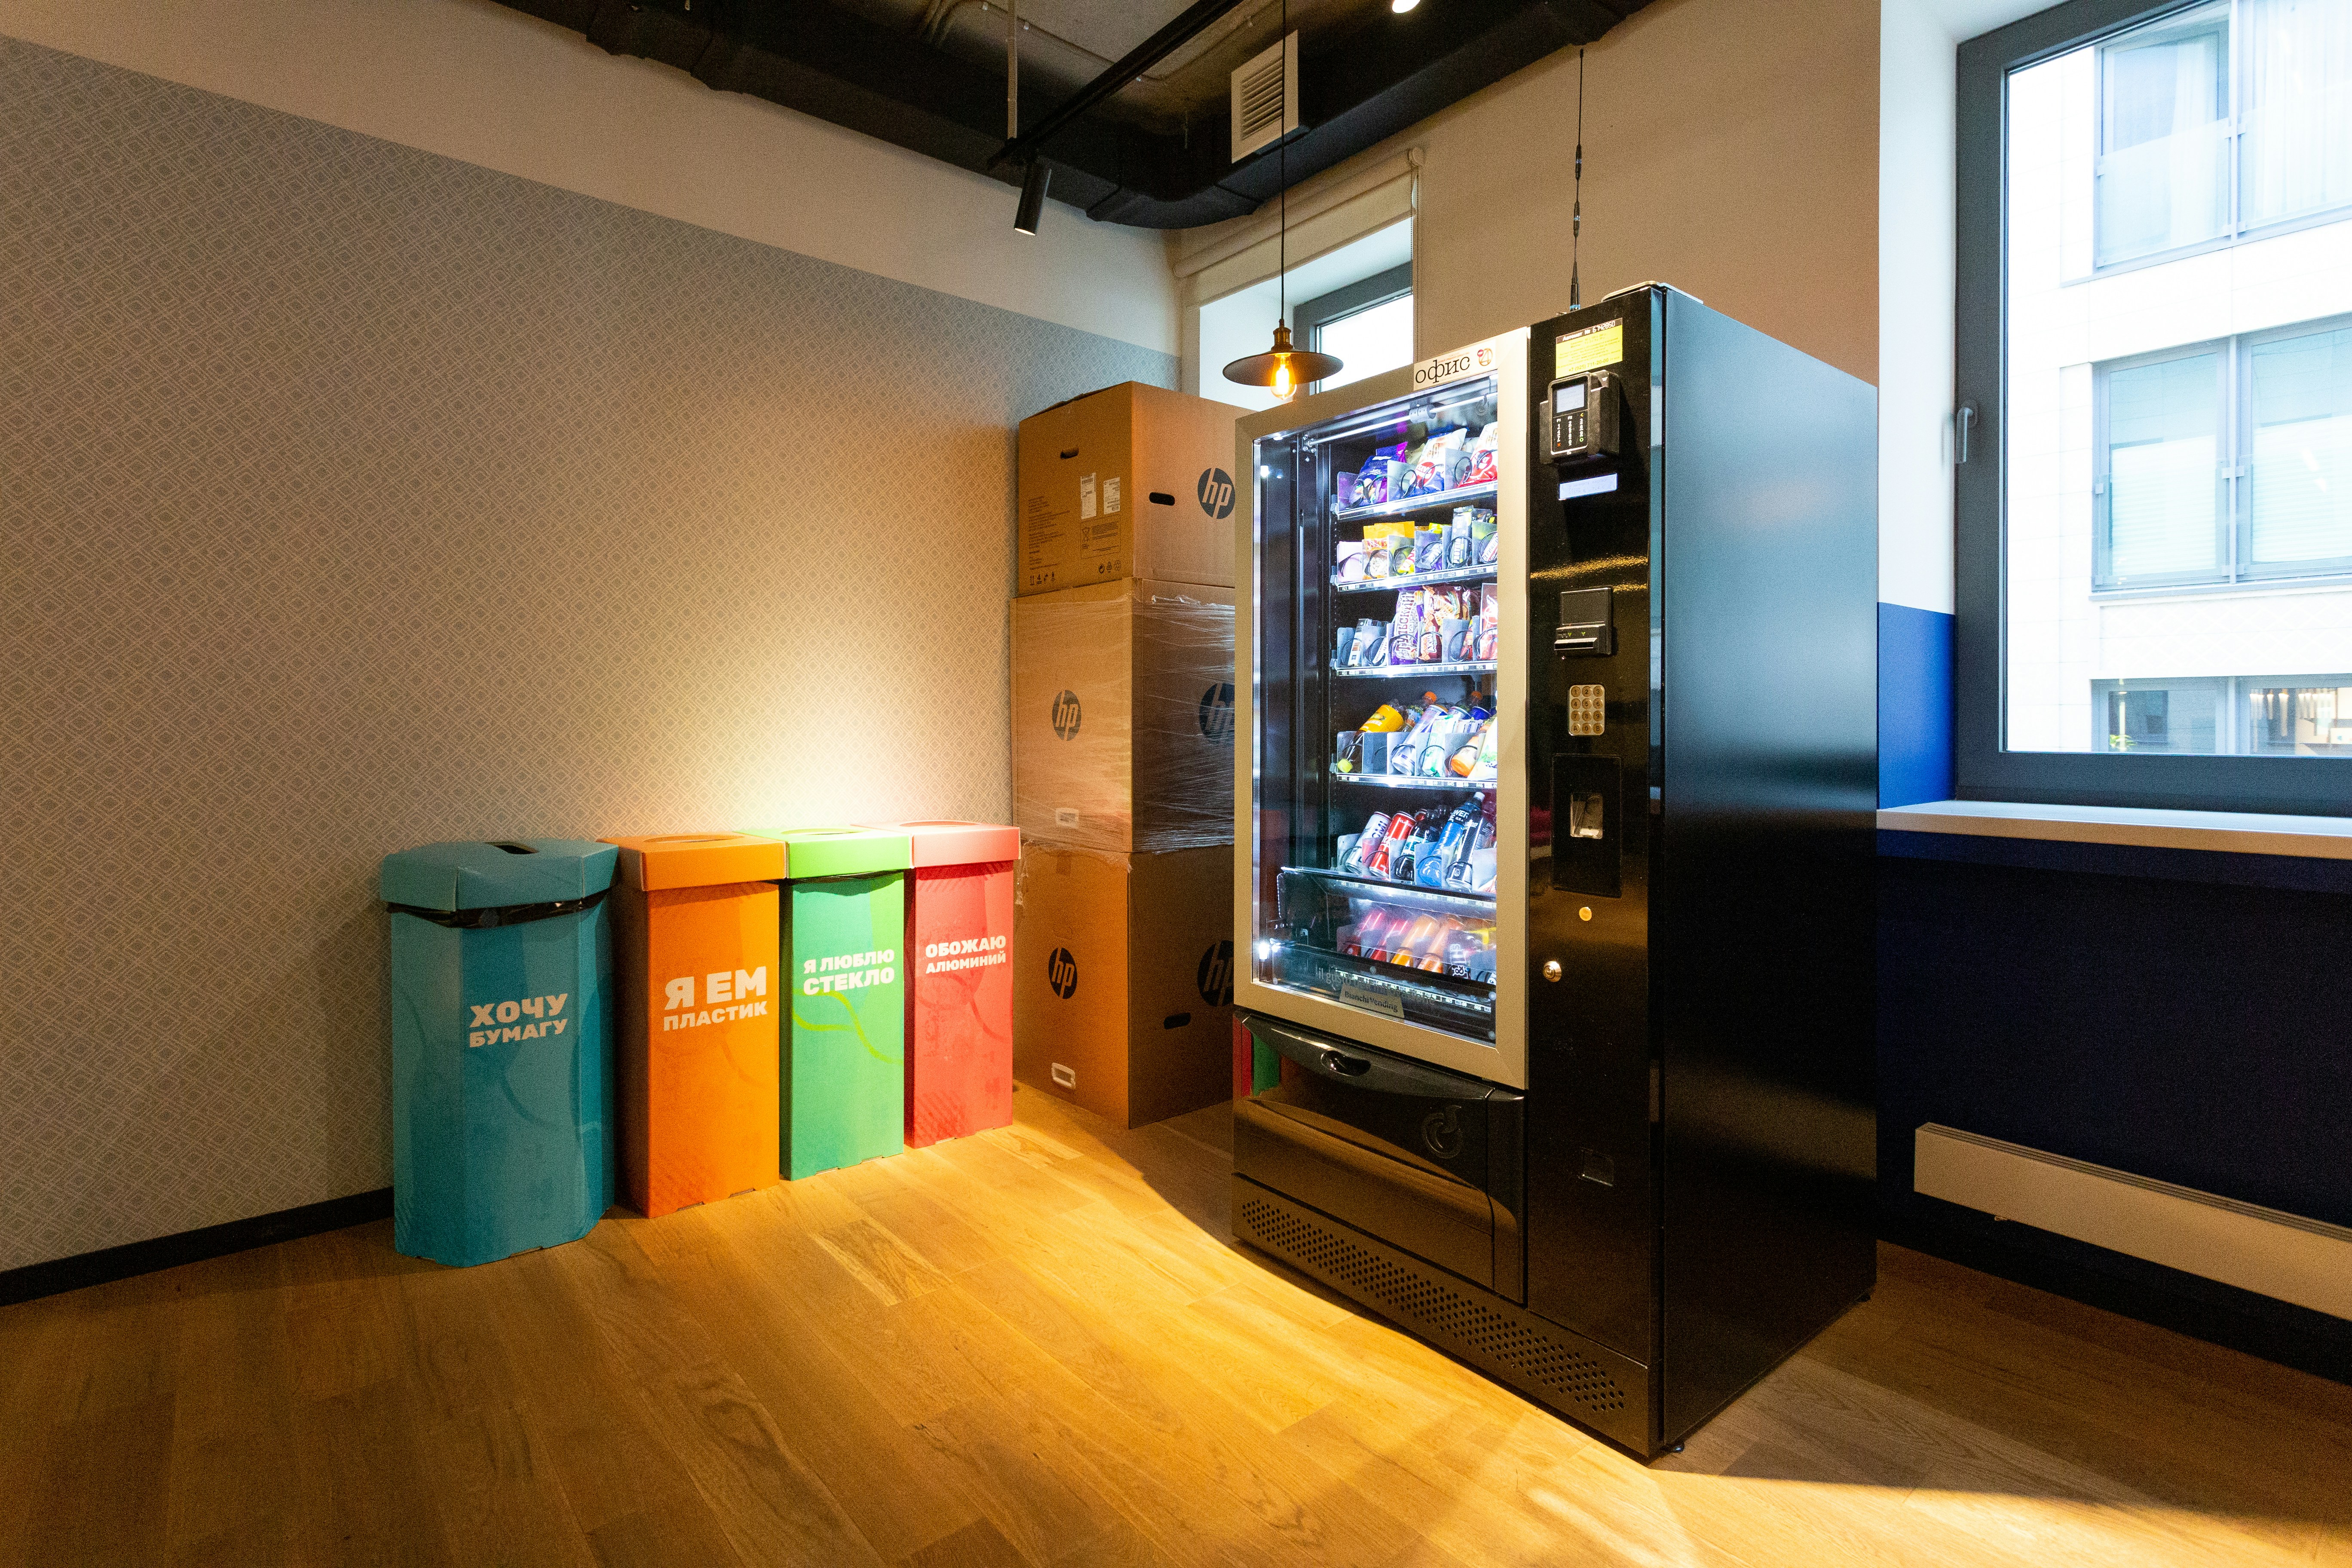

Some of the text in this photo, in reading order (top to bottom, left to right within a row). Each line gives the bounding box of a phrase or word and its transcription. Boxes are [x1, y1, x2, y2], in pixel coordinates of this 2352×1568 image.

[1415, 357, 1470, 384] офис
[1587, 358, 1609, 368] 711-20-00
[1202, 468, 1233, 519] hp
[1396, 591, 1415, 652] ТУЛЬСКИЙ
[1055, 689, 1079, 741] hp
[1452, 809, 1470, 819] WER
[804, 948, 894, 974] Я ЛЮБЛЮ
[925, 935, 1007, 958] ОБОЖАЮ
[925, 950, 1007, 974] АЛЮМИНИЙ
[1050, 947, 1075, 999] hp
[665, 965, 767, 1010] Я ЕМ
[804, 967, 894, 995] СТЕКЛО
[470, 993, 568, 1027] ХОЧУ
[664, 1000, 767, 1031] ПЛАСТИК
[1344, 990, 1369, 1004] Bianchi
[1369, 997, 1398, 1013] Vending
[470, 1018, 567, 1048] БУМАГУ
